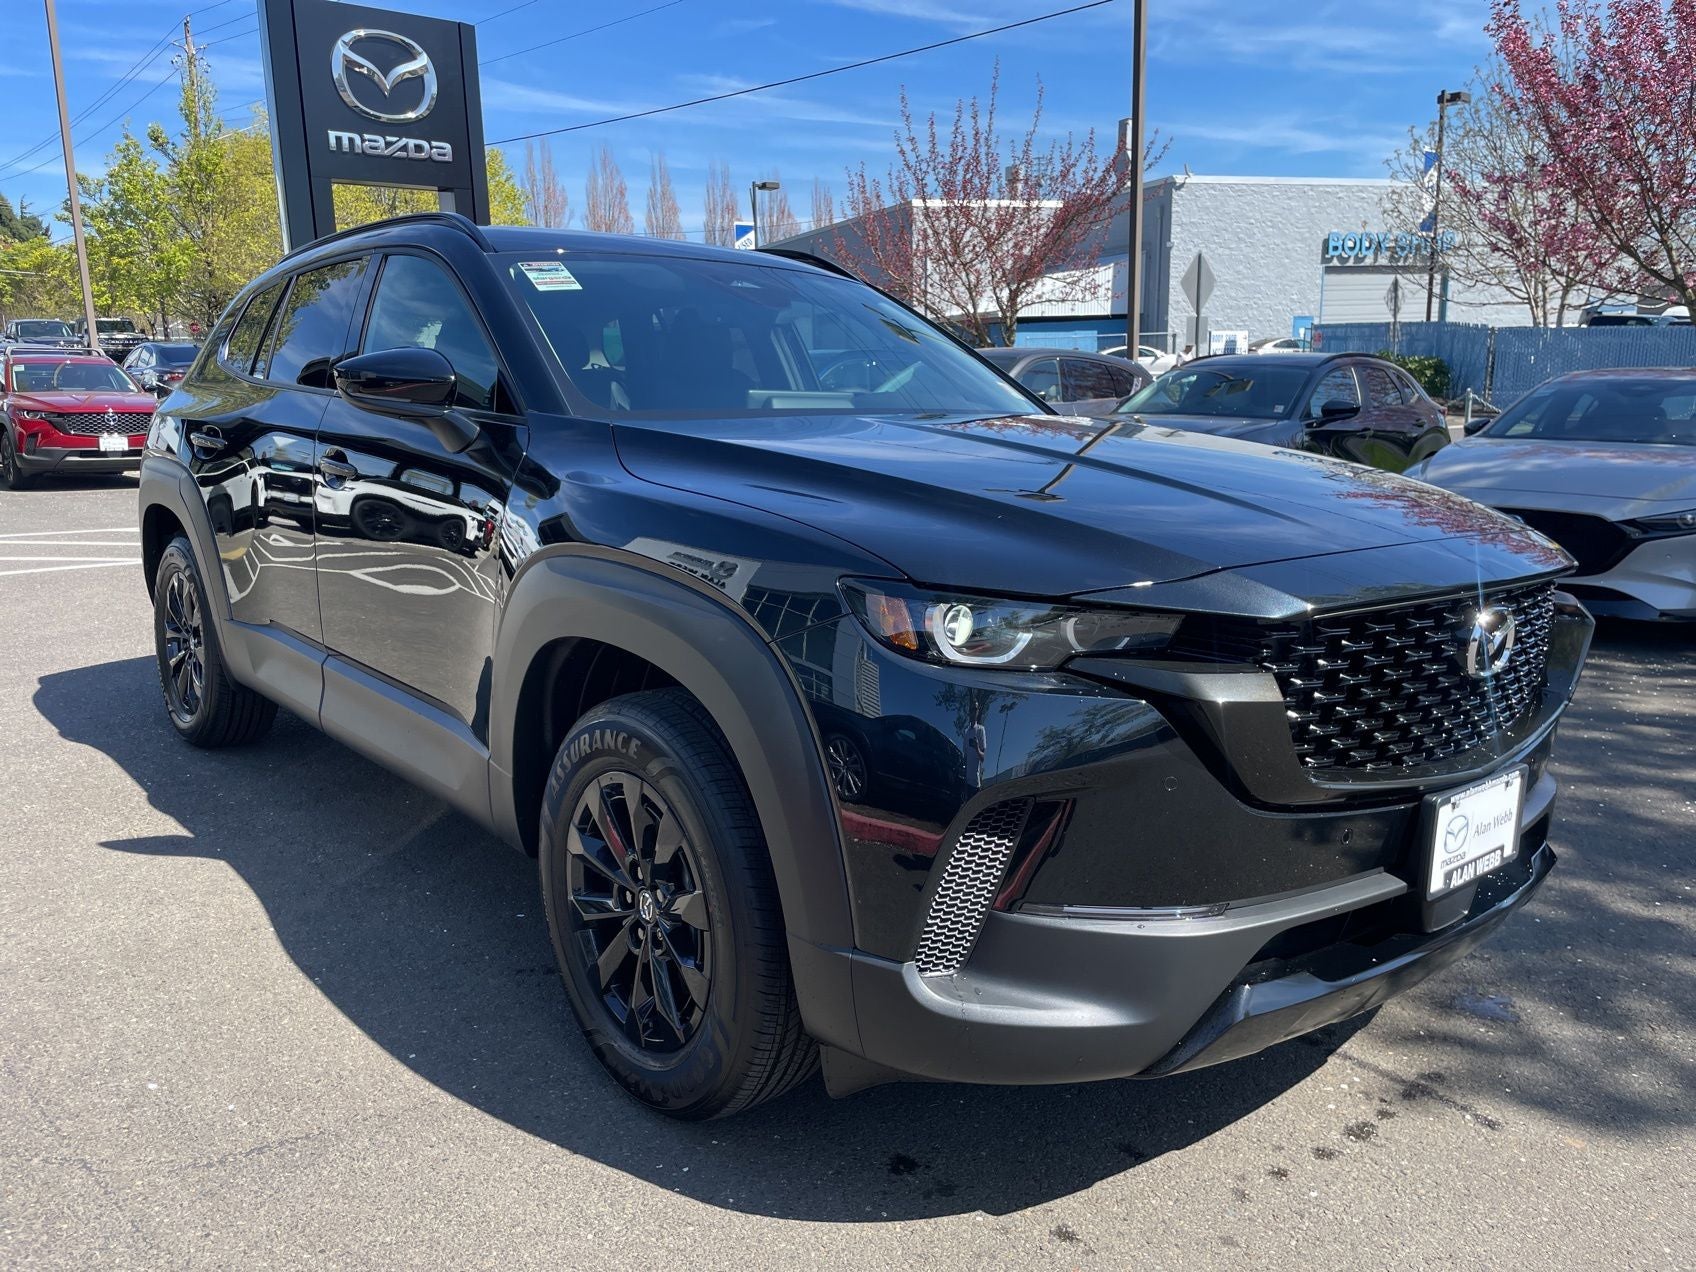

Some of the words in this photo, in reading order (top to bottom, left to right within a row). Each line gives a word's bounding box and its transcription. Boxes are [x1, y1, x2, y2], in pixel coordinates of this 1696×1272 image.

[327, 129, 453, 162] mazda
[1327, 230, 1391, 257] BODY
[551, 728, 642, 800] ASSURANCE
[1473, 821, 1492, 838] Alan
[1494, 807, 1513, 829] Webb
[1450, 861, 1475, 889] ALAN
[1476, 849, 1502, 876] WEBB
